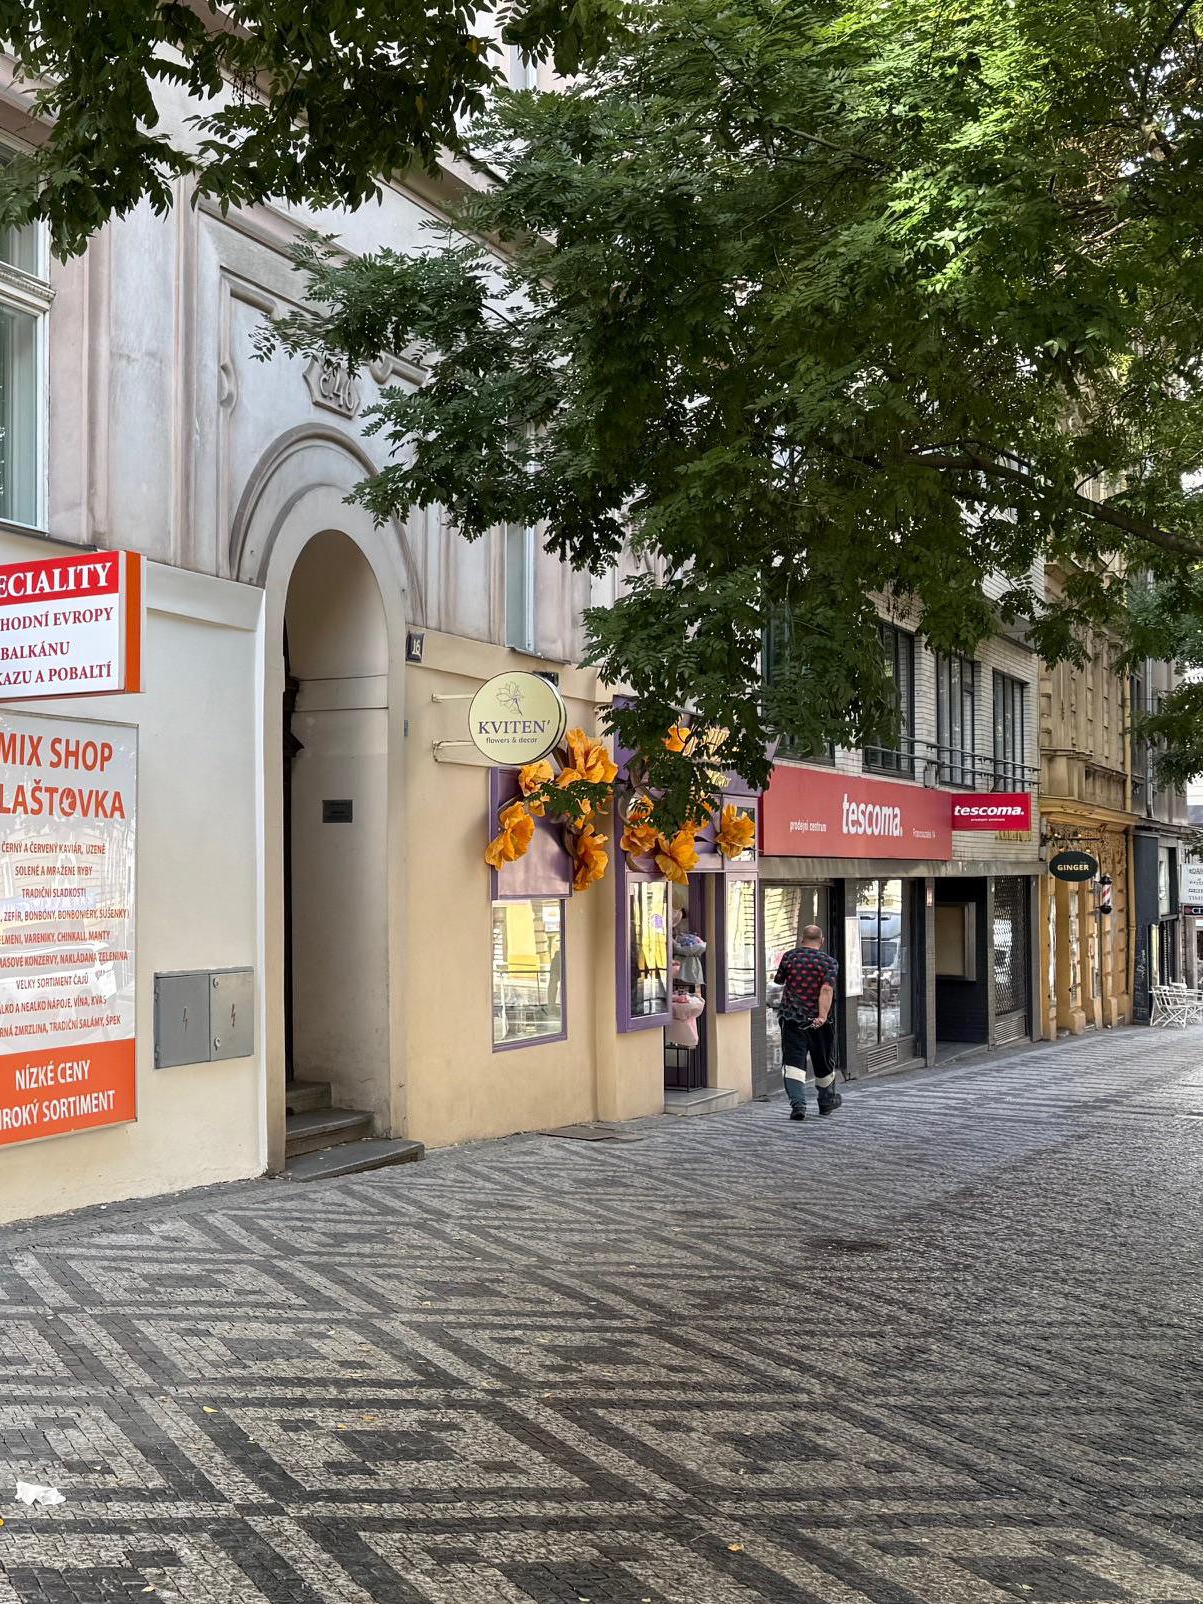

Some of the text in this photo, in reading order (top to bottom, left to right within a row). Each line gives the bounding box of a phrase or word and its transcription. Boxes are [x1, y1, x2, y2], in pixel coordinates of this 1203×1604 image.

[54, 607, 113, 626] EVROPY
[1, 640, 70, 660] BALKÁNU
[35, 671, 44, 682] A
[48, 661, 111, 682] POBALTÍ
[50, 736, 112, 772] SHOP
[843, 794, 902, 837] tescoma.
[954, 805, 1024, 816] tescoma.
[23, 843, 28, 853] A
[41, 866, 45, 876] A
[77, 866, 92, 876] RYBY
[53, 888, 86, 898] SLADKOSTI
[15, 1003, 20, 1013] A
[15, 1059, 90, 1091] NÍZKÉ CENY
[42, 1090, 115, 1123] SORTIMENT
